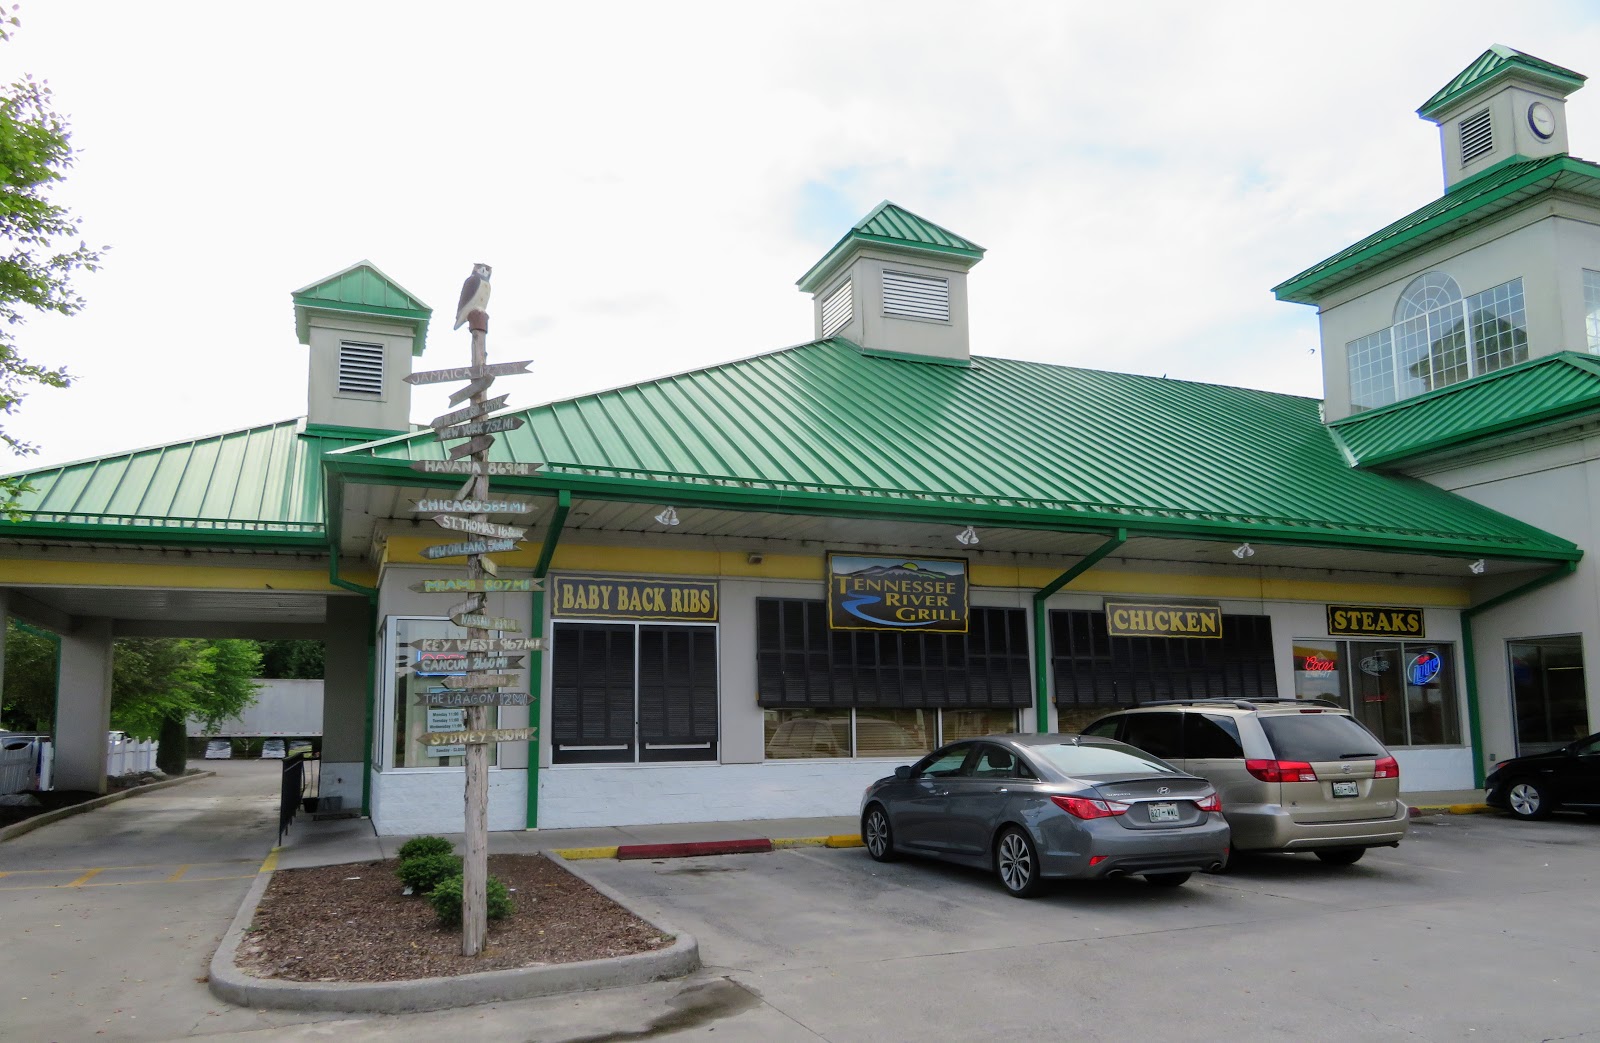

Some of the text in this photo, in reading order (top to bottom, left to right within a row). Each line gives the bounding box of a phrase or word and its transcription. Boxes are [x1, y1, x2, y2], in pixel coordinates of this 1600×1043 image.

[411, 366, 472, 385] JAMAICA
[441, 426, 460, 438] NEW
[462, 423, 484, 435] YORK
[424, 461, 482, 475] HAVANA
[418, 499, 482, 512] CHICAGO
[460, 519, 496, 535] THOMAS
[428, 545, 446, 558] NEW
[447, 541, 486, 554] ORLEANS
[424, 580, 476, 593] MIAMI
[834, 576, 956, 595] TENNESSEE
[562, 584, 711, 614] BABY BACK RIBS
[885, 592, 949, 607] RIVER
[895, 607, 961, 621] GRILL
[1113, 609, 1216, 633] CHICKEN
[1334, 610, 1420, 633] STEAKS
[421, 638, 452, 652] KEY
[456, 638, 498, 652] WEST
[421, 660, 469, 671] CANCUN
[1305, 655, 1335, 671] Coors
[424, 694, 445, 704] THE
[447, 693, 496, 704] DRAGON
[430, 732, 487, 745] SYDNEY
